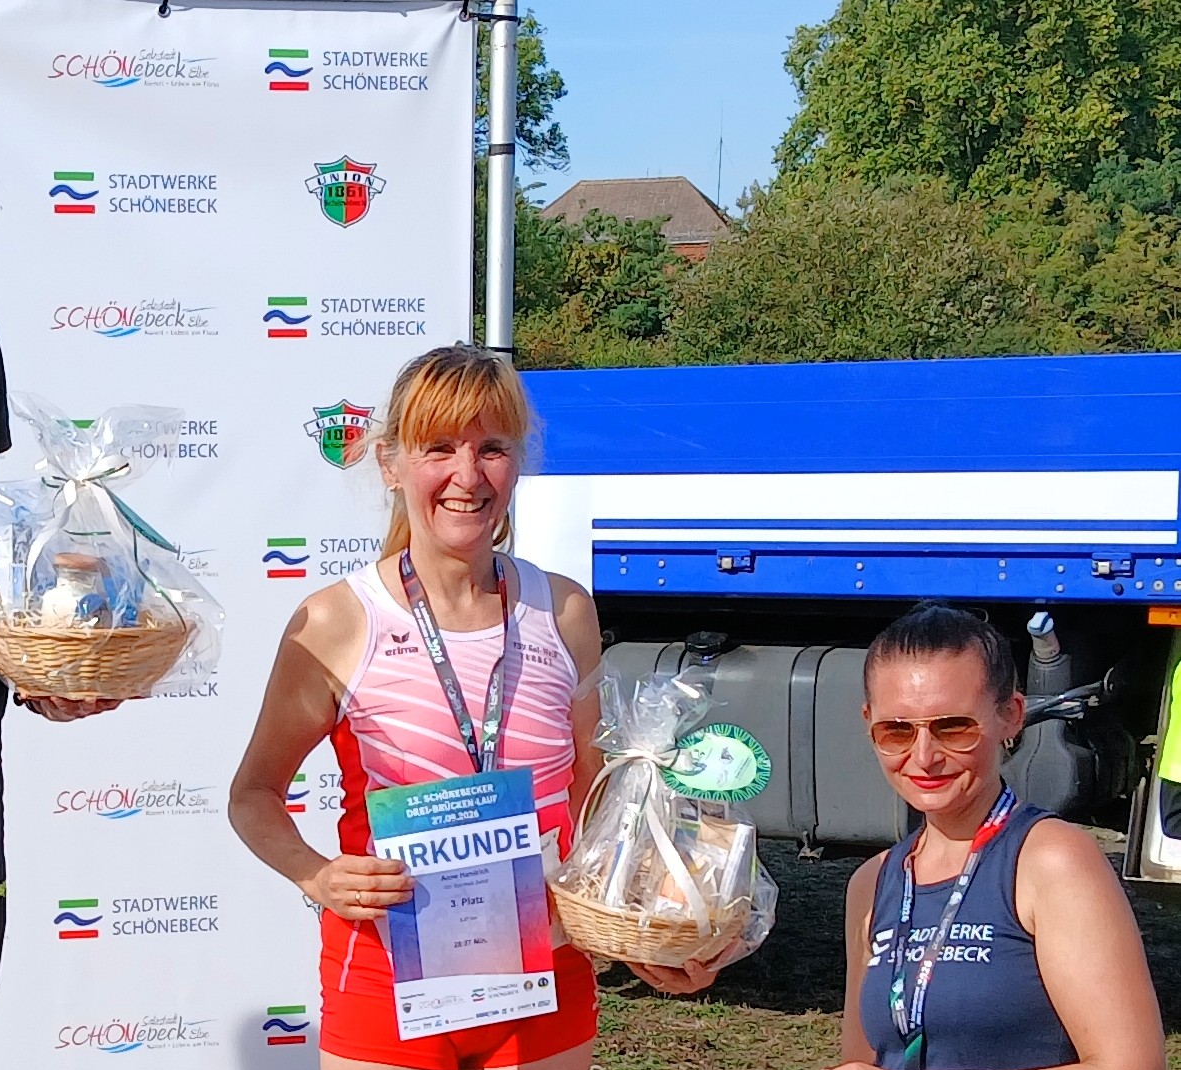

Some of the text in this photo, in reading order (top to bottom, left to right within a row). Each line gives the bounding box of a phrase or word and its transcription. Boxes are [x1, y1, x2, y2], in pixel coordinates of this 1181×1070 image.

[48, 51, 186, 79] SCHÖNebeck
[323, 51, 428, 67] STADTWERKE
[324, 73, 428, 90] SCHÖNEBECK
[109, 174, 217, 190] STADTWERKE
[317, 172, 373, 187] UNION
[326, 187, 362, 198] 1861
[109, 195, 217, 213] SCHÖNEBECK
[321, 298, 425, 313] STADTWERKE
[50, 301, 184, 330] SCHÖNebeck
[321, 319, 425, 335] SCHÖNEBECK
[385, 646, 418, 656] erima
[54, 784, 186, 815] SCHÖNebeck
[423, 784, 494, 803] SCHÖNEBECKER
[113, 895, 218, 913] STADTWERKE
[461, 896, 485, 905] Platz
[113, 917, 218, 935] SCHÖNEBECK
[55, 1018, 187, 1050] SCHÖNebeck
